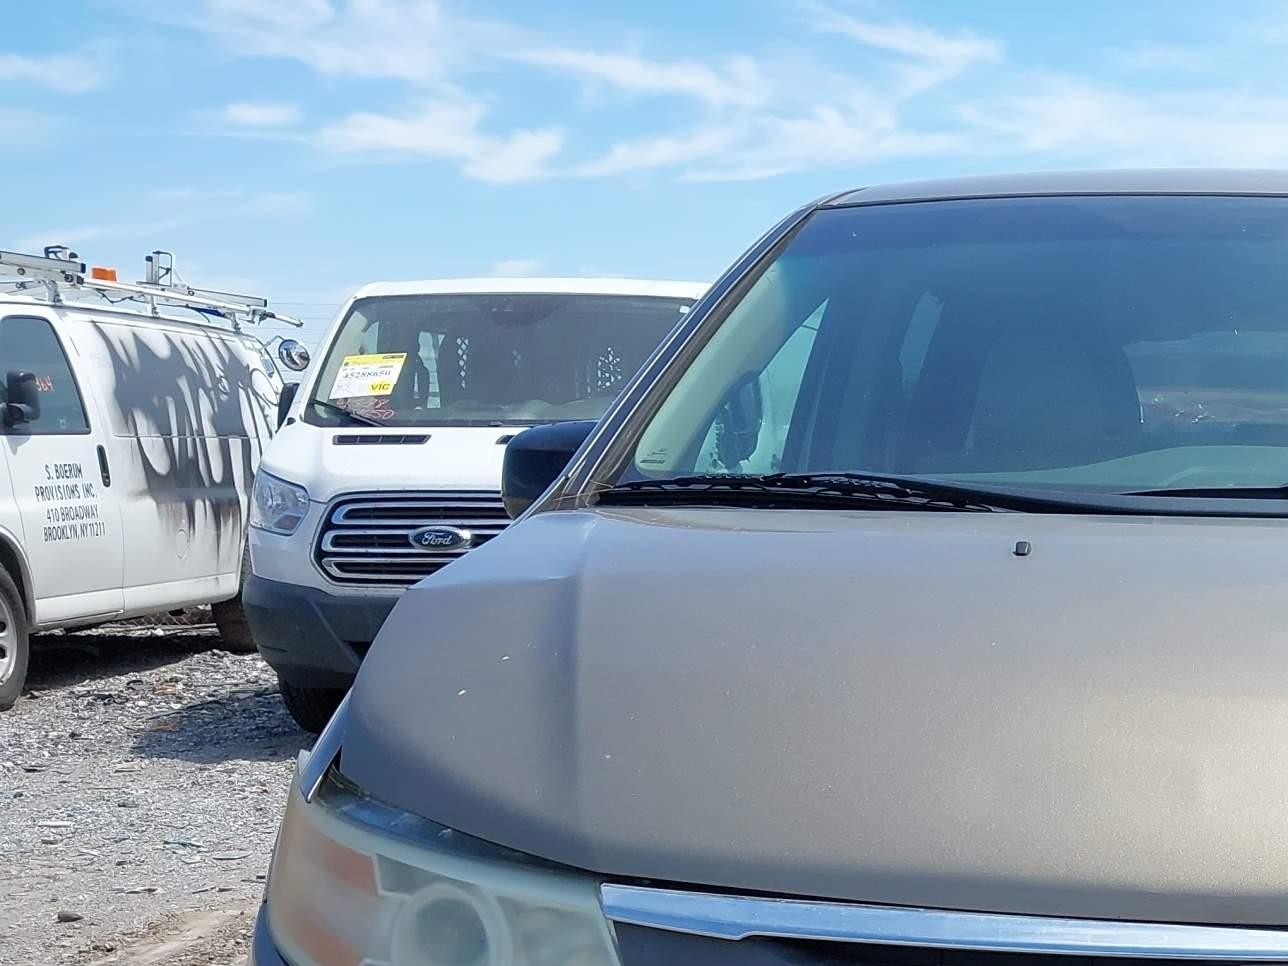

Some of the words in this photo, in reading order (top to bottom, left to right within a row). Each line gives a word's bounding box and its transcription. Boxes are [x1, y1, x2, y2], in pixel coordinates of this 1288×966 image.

[45, 463, 54, 480] S.
[54, 463, 83, 480] BOERUM
[34, 483, 81, 502] PROVISIONS
[82, 482, 98, 499] INC.
[47, 507, 60, 522] 410
[60, 504, 99, 521] BROADWAY
[80, 522, 88, 538] NY
[89, 521, 106, 537] 11211
[421, 532, 452, 545] Ford
